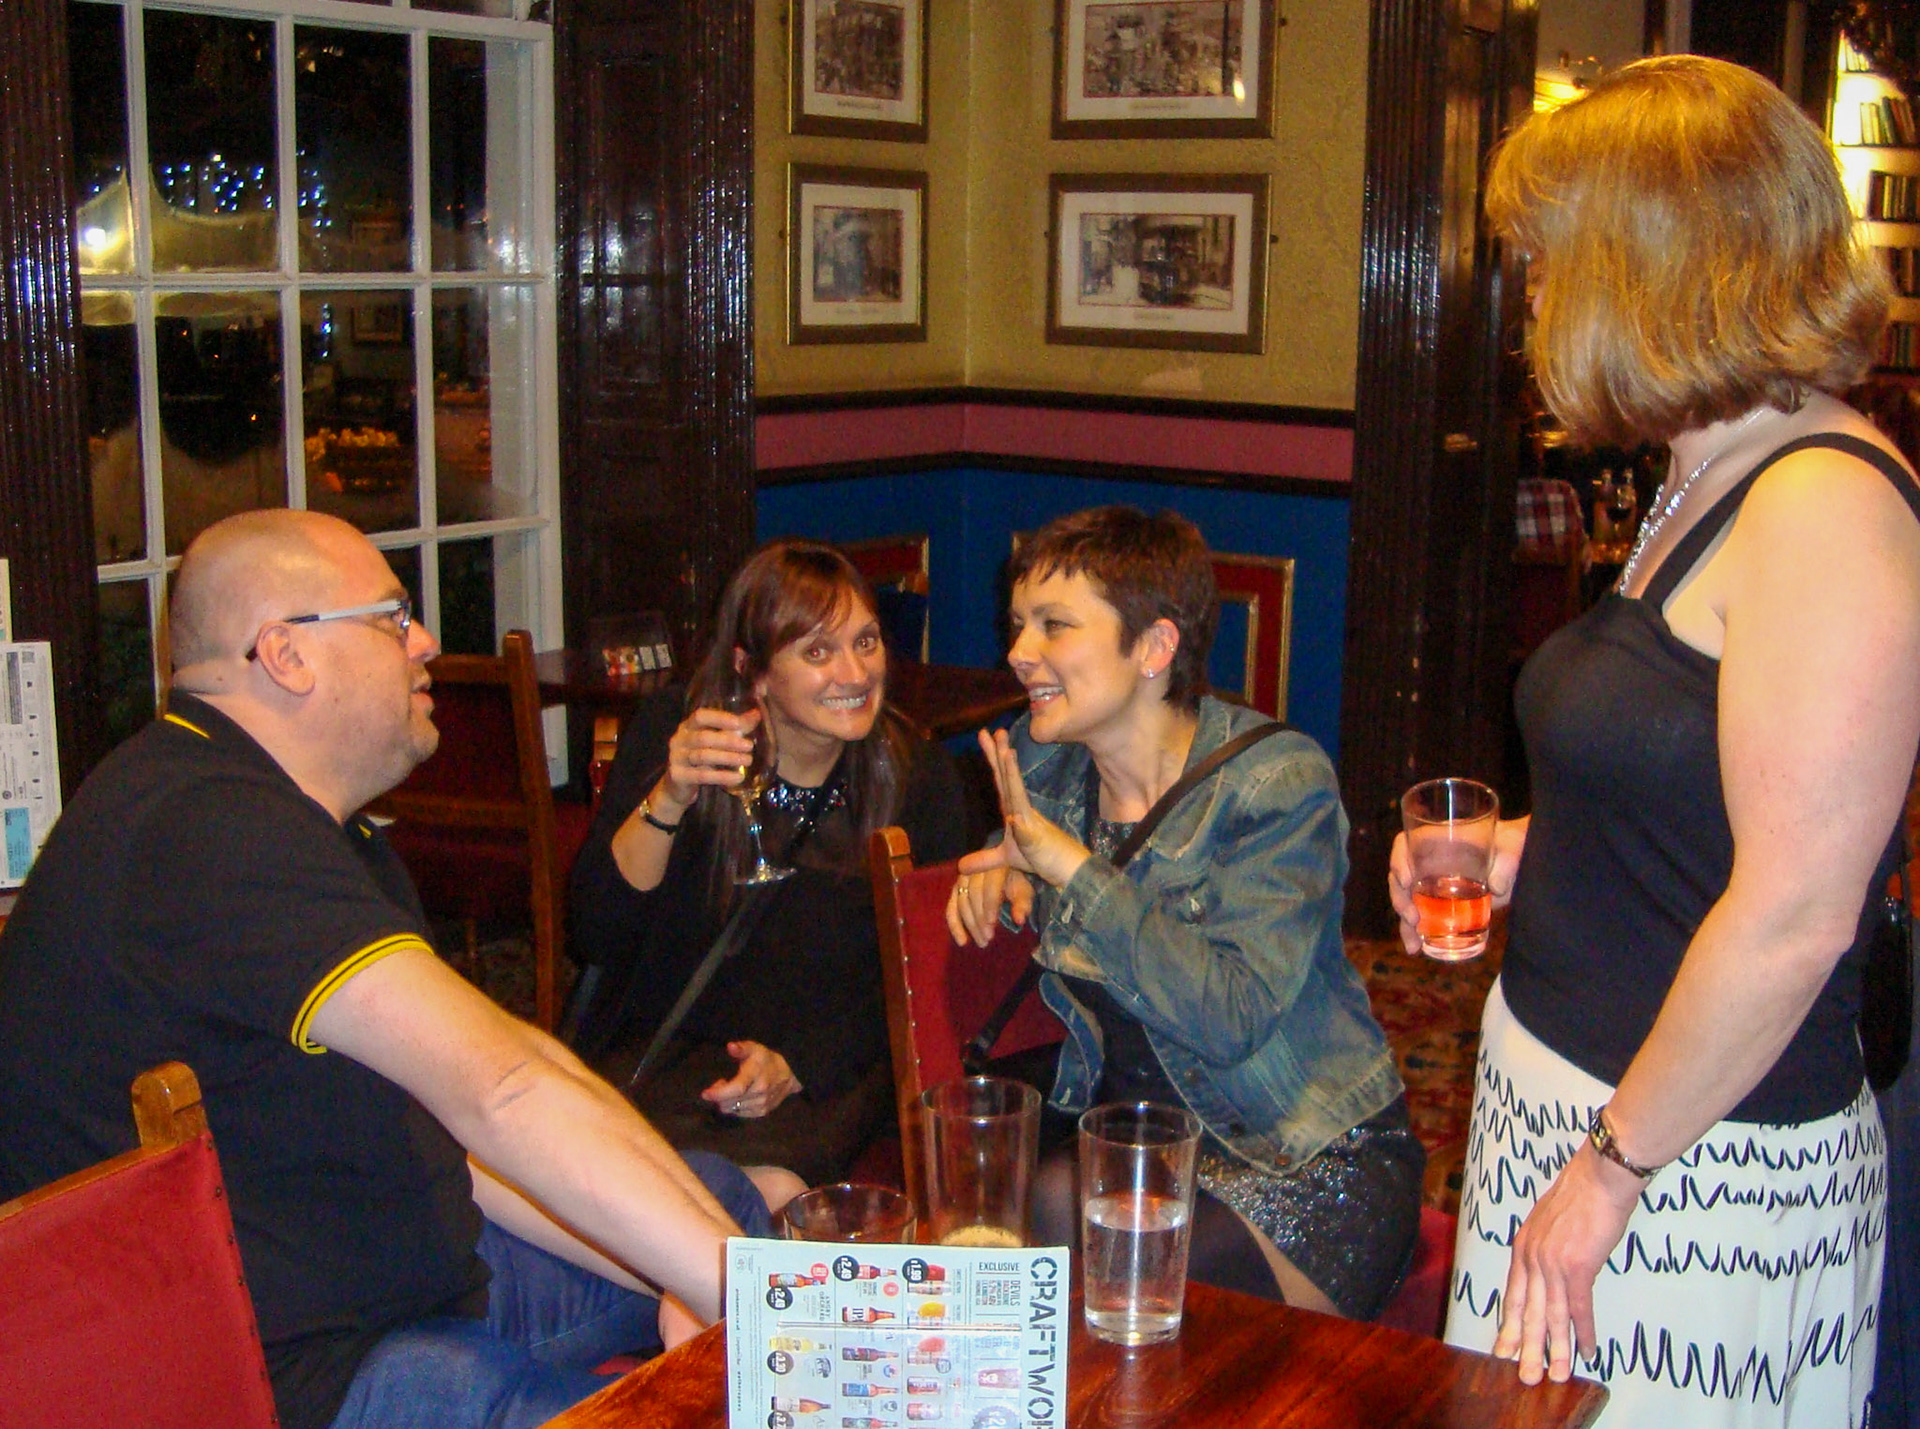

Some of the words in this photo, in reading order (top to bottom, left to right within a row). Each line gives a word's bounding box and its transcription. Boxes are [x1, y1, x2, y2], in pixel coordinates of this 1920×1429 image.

[841, 1257, 852, 1280] £2.49
[910, 1260, 922, 1281] £1.99
[979, 1262, 1020, 1271] EXCLUSIVE
[774, 1288, 786, 1308] £2.49
[1010, 1280, 1021, 1306] DEVILS
